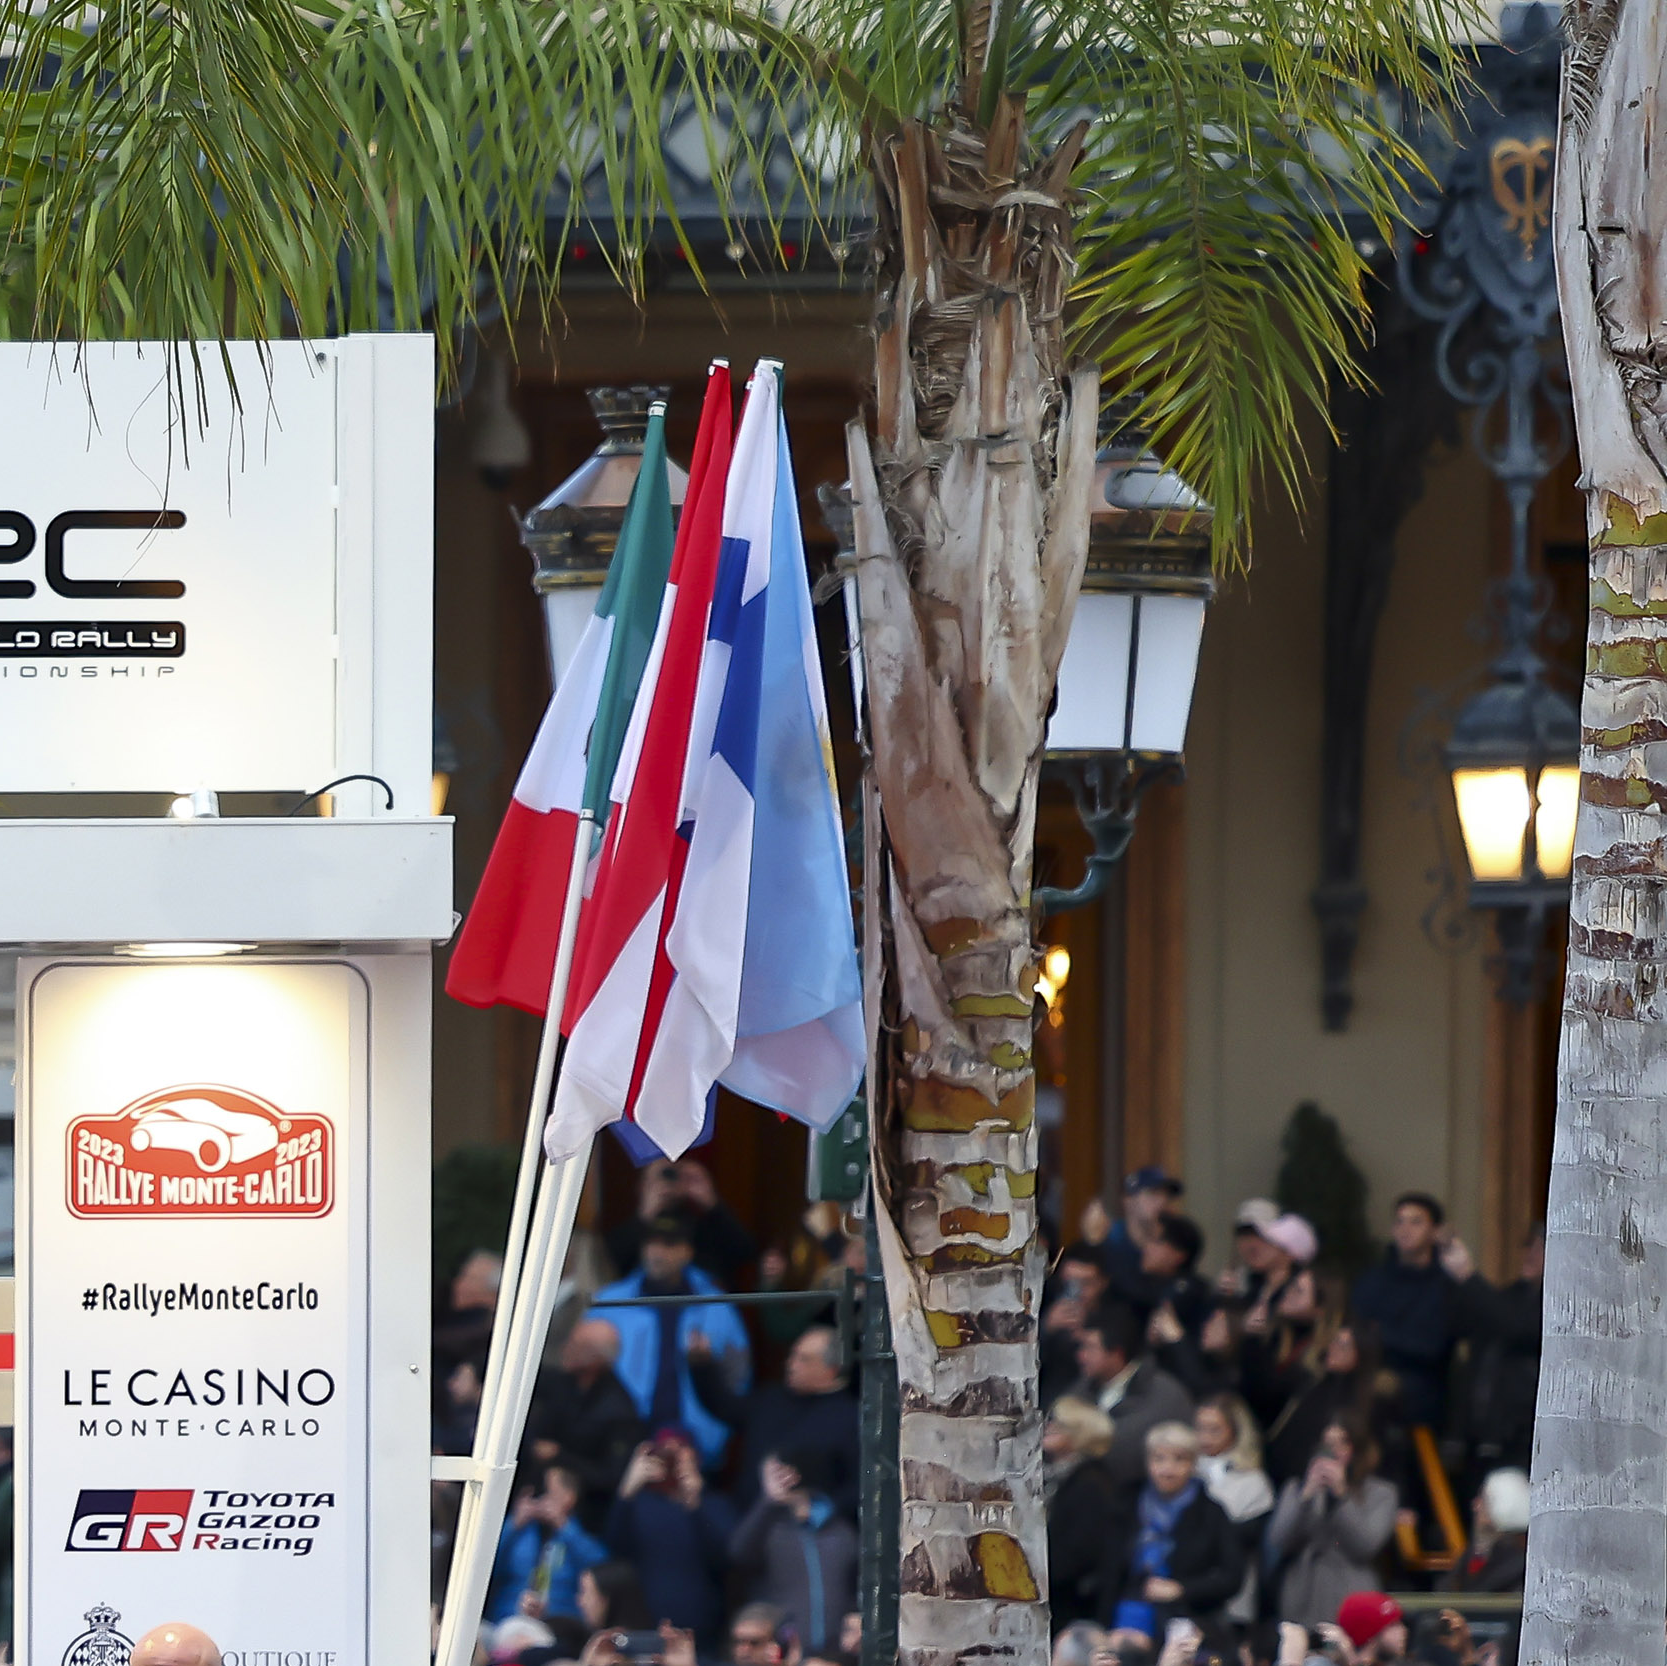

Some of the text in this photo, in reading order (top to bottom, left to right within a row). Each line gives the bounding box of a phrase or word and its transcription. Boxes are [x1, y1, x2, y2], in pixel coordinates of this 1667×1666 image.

[51, 630, 178, 649] RALLY
[77, 1129, 125, 1166] 2023
[275, 1129, 322, 1166] 2023
[78, 1150, 323, 1206] RALLYE MONTE-CARLO
[81, 1282, 318, 1317] #RallyeMonteCarlo
[64, 1368, 335, 1406] LE CASINO
[203, 1491, 335, 1508] TOYOTA
[70, 1513, 185, 1550] GR
[198, 1514, 320, 1528] GAZOO
[193, 1532, 314, 1556] Racing
